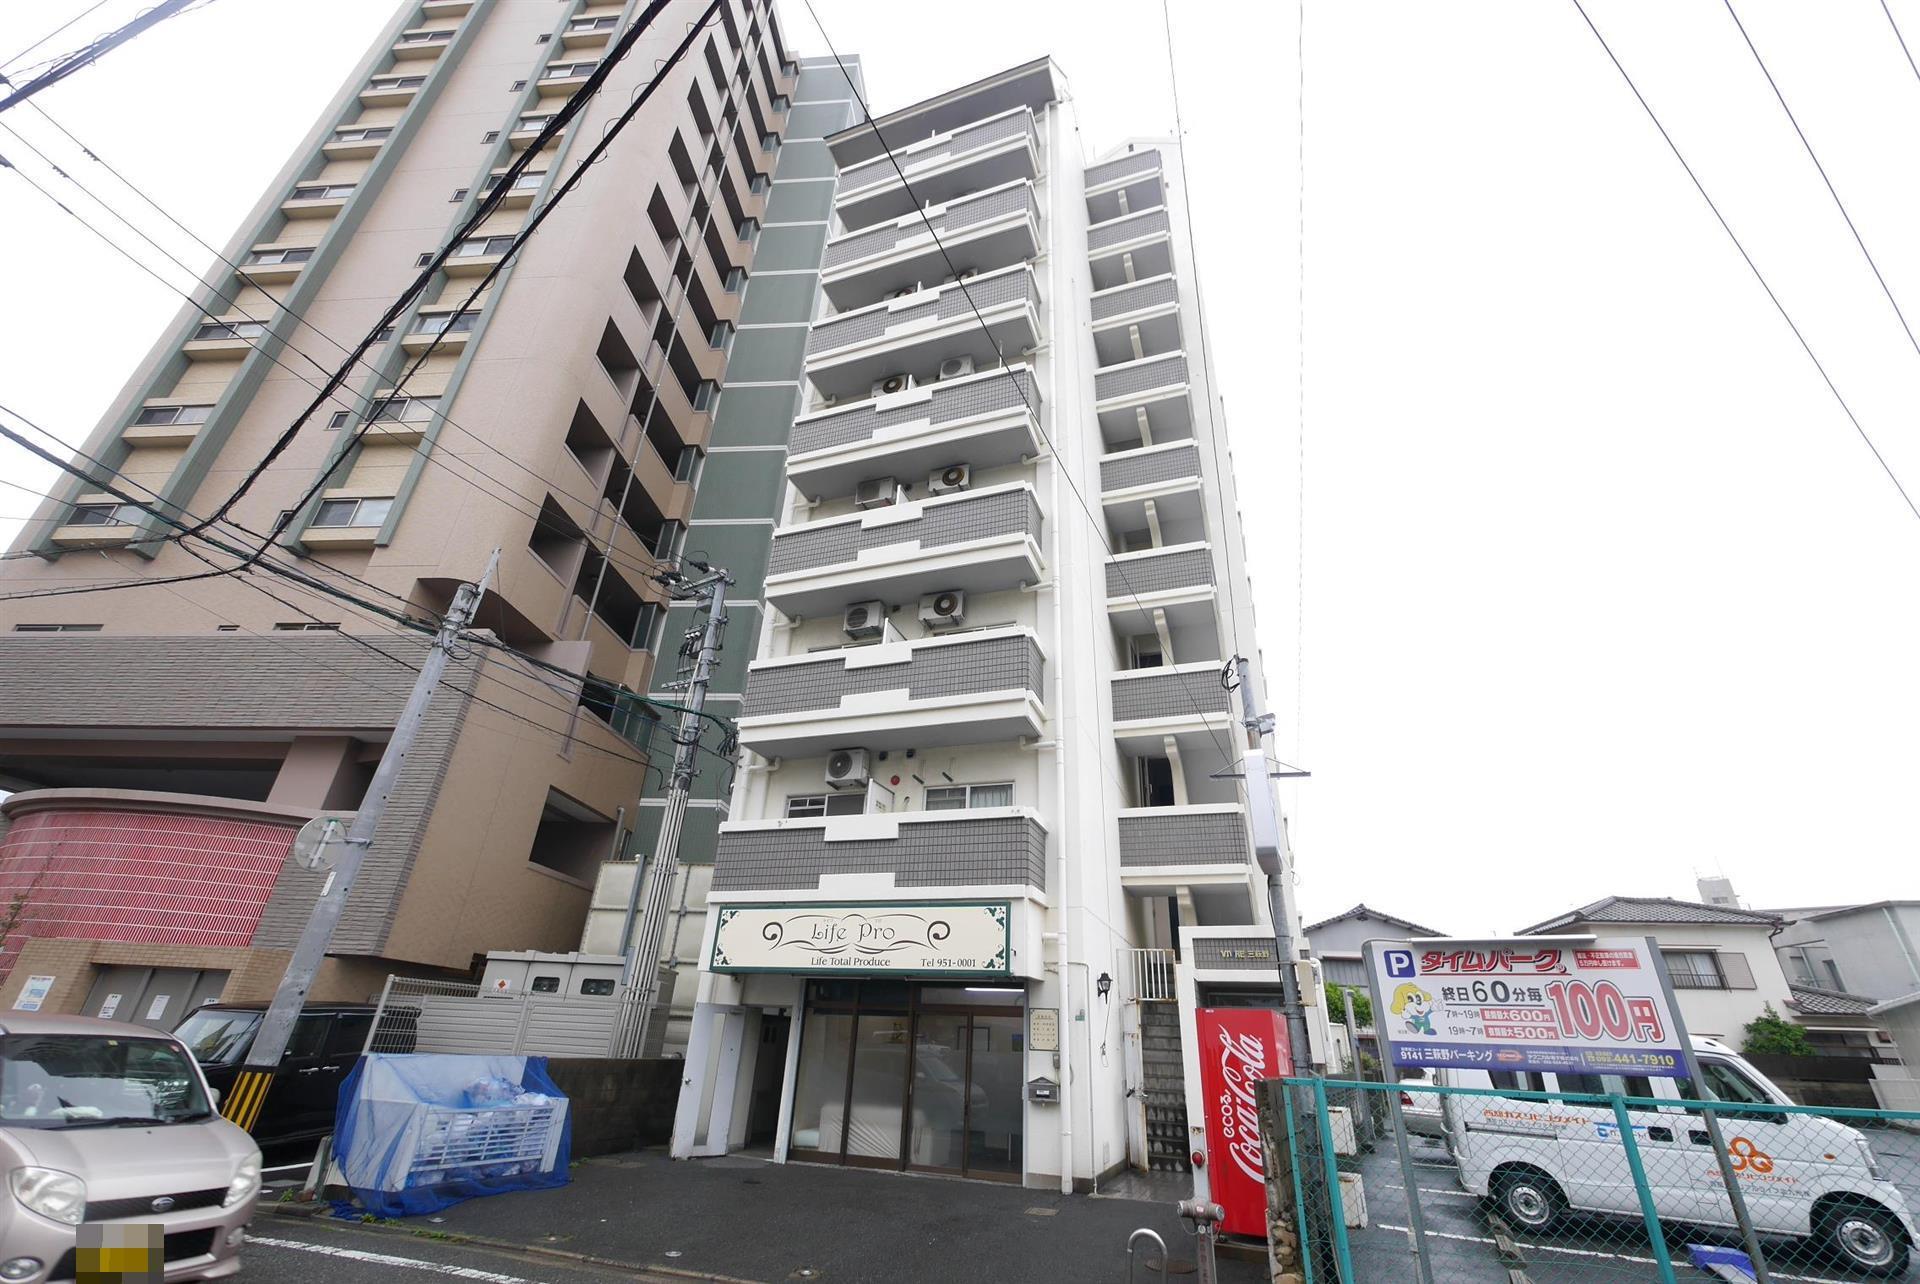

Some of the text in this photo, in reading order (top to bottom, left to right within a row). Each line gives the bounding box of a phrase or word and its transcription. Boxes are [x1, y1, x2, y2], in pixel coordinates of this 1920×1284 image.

[811, 922, 896, 944] Life Pro
[811, 957, 890, 967] Life Total Produce
[921, 958, 976, 968] Tel 951-0001
[1389, 953, 1409, 976] P
[1421, 949, 1562, 972] タイムパーク
[1442, 980, 1543, 1003] 終日60分毎
[1545, 980, 1665, 1043] 100円
[1400, 1051, 1423, 1061] 9141
[1424, 1048, 1493, 1062] 三萩野パーキング
